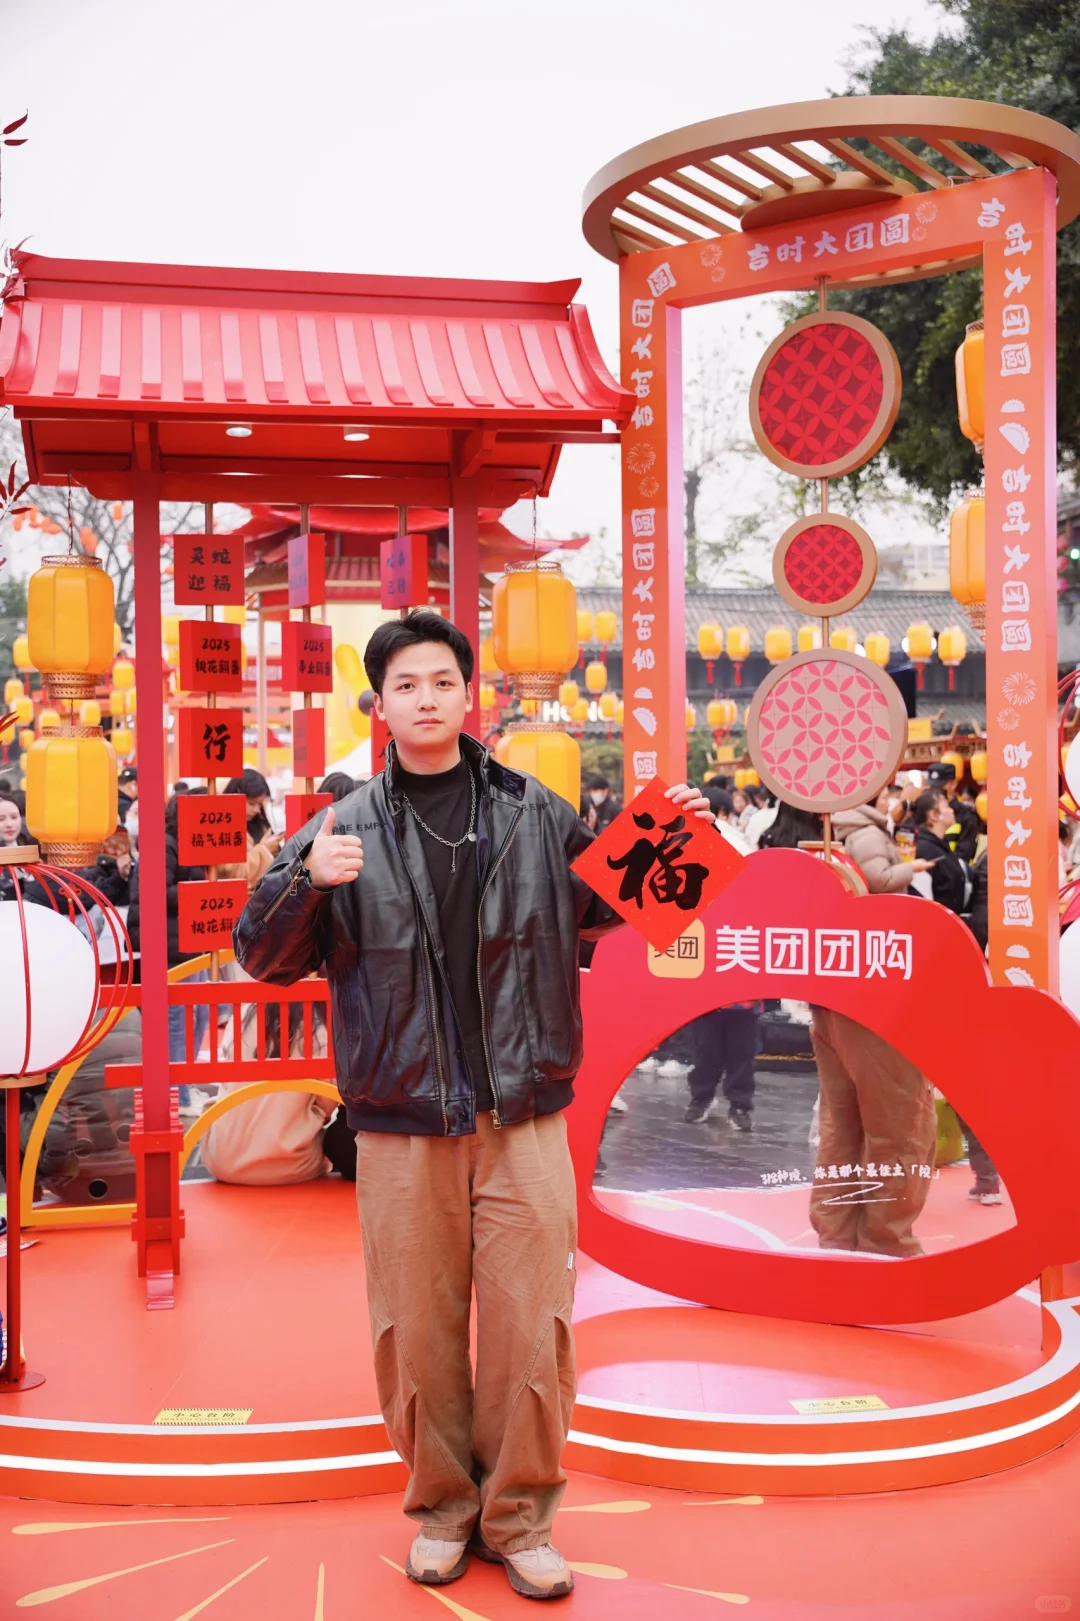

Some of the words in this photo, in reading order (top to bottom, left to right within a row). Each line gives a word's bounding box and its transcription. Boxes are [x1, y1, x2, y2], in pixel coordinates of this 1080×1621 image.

[202, 638, 231, 651] 2025
[303, 640, 325, 652] 2025
[203, 723, 231, 761] 行
[200, 812, 232, 824] 2025
[606, 811, 709, 910] 福
[200, 898, 234, 911] 2025
[191, 917, 239, 935] 桃花翻
[715, 925, 913, 980] 美团团购
